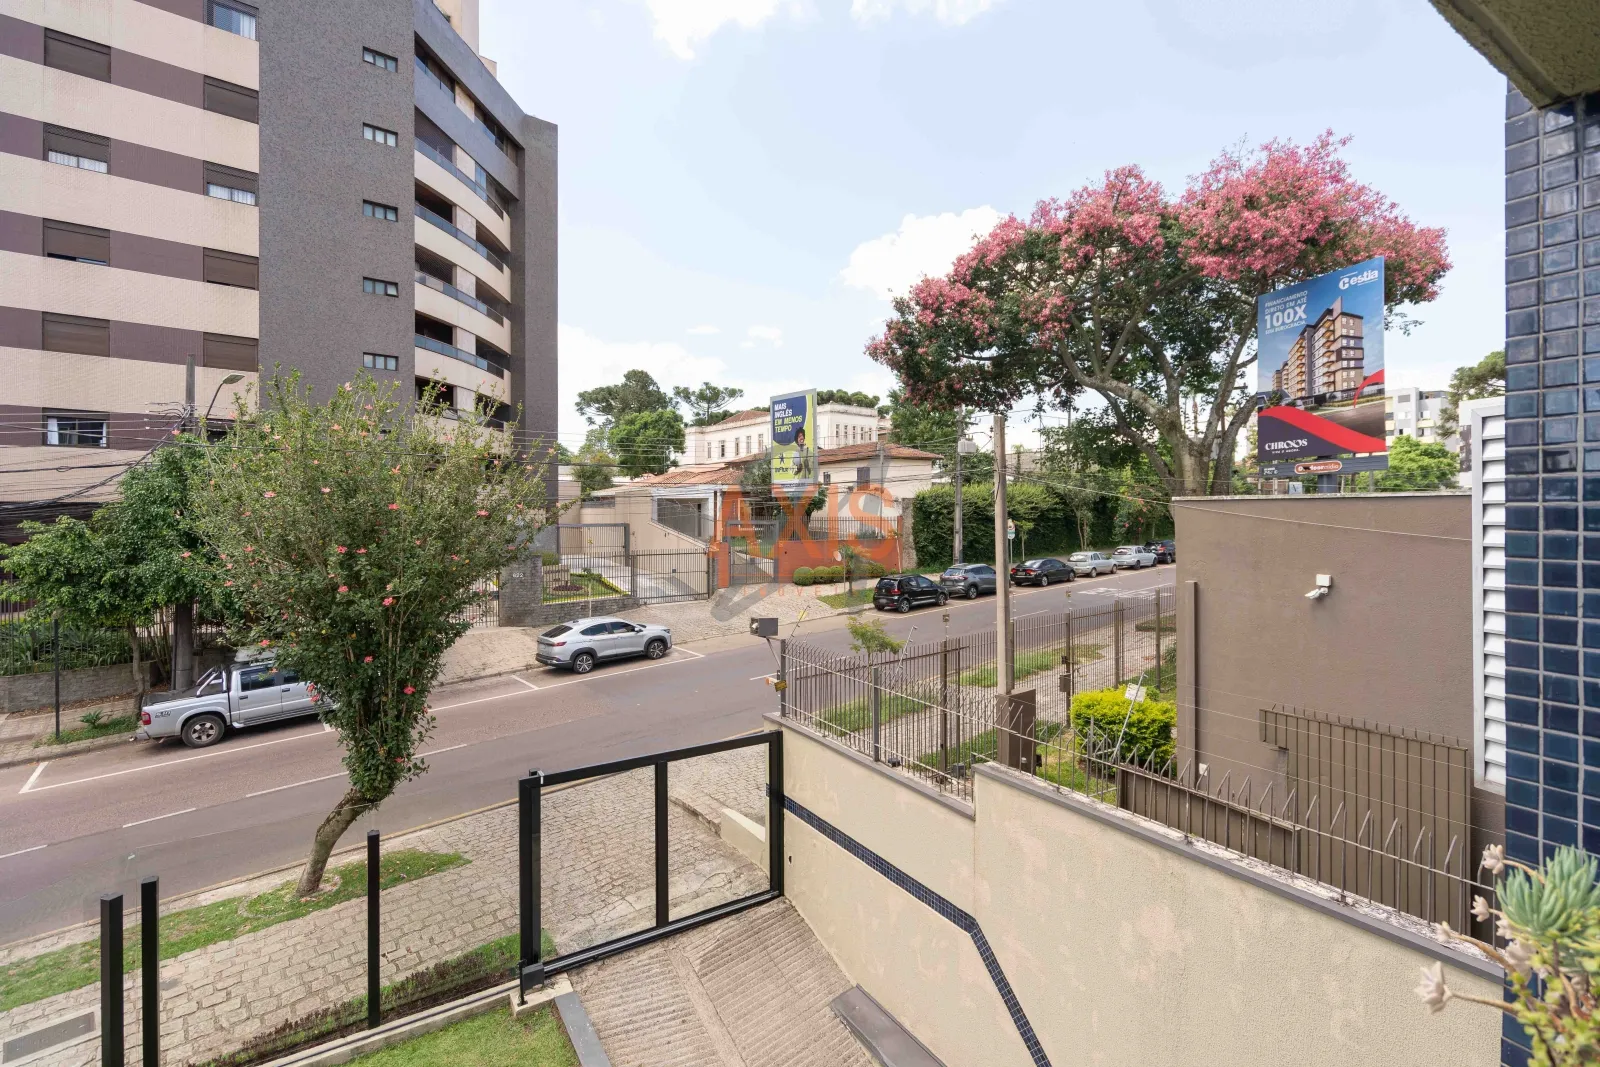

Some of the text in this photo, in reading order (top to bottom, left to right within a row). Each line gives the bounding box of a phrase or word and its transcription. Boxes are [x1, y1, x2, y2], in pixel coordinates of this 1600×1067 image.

[1264, 303, 1308, 329] 100X
[774, 402, 787, 411] MAIS
[774, 415, 803, 426] EM MENOS
[774, 425, 792, 433] TEMPO
